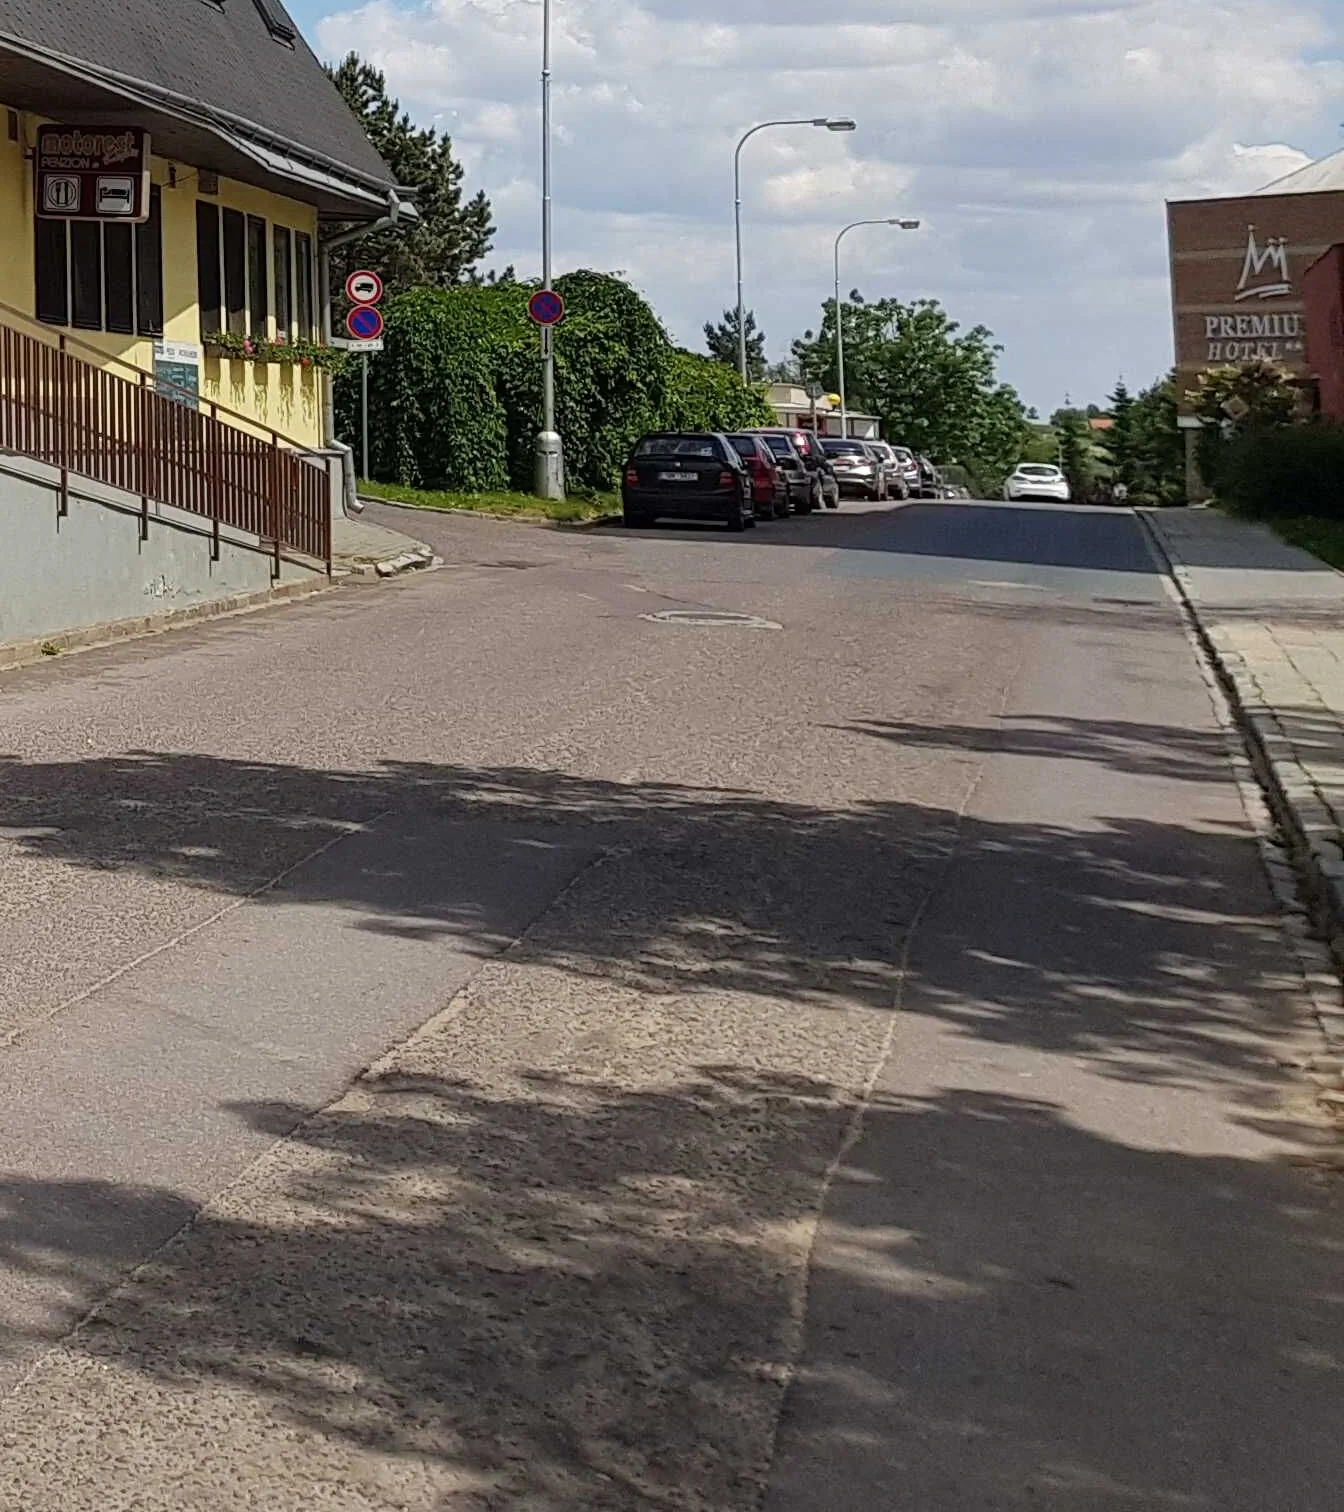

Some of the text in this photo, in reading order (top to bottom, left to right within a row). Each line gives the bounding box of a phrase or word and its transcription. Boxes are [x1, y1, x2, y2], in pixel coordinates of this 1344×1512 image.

[40, 130, 135, 156] motorest
[1205, 314, 1306, 338] PREMIU
[1207, 341, 1284, 361] HOTEL
